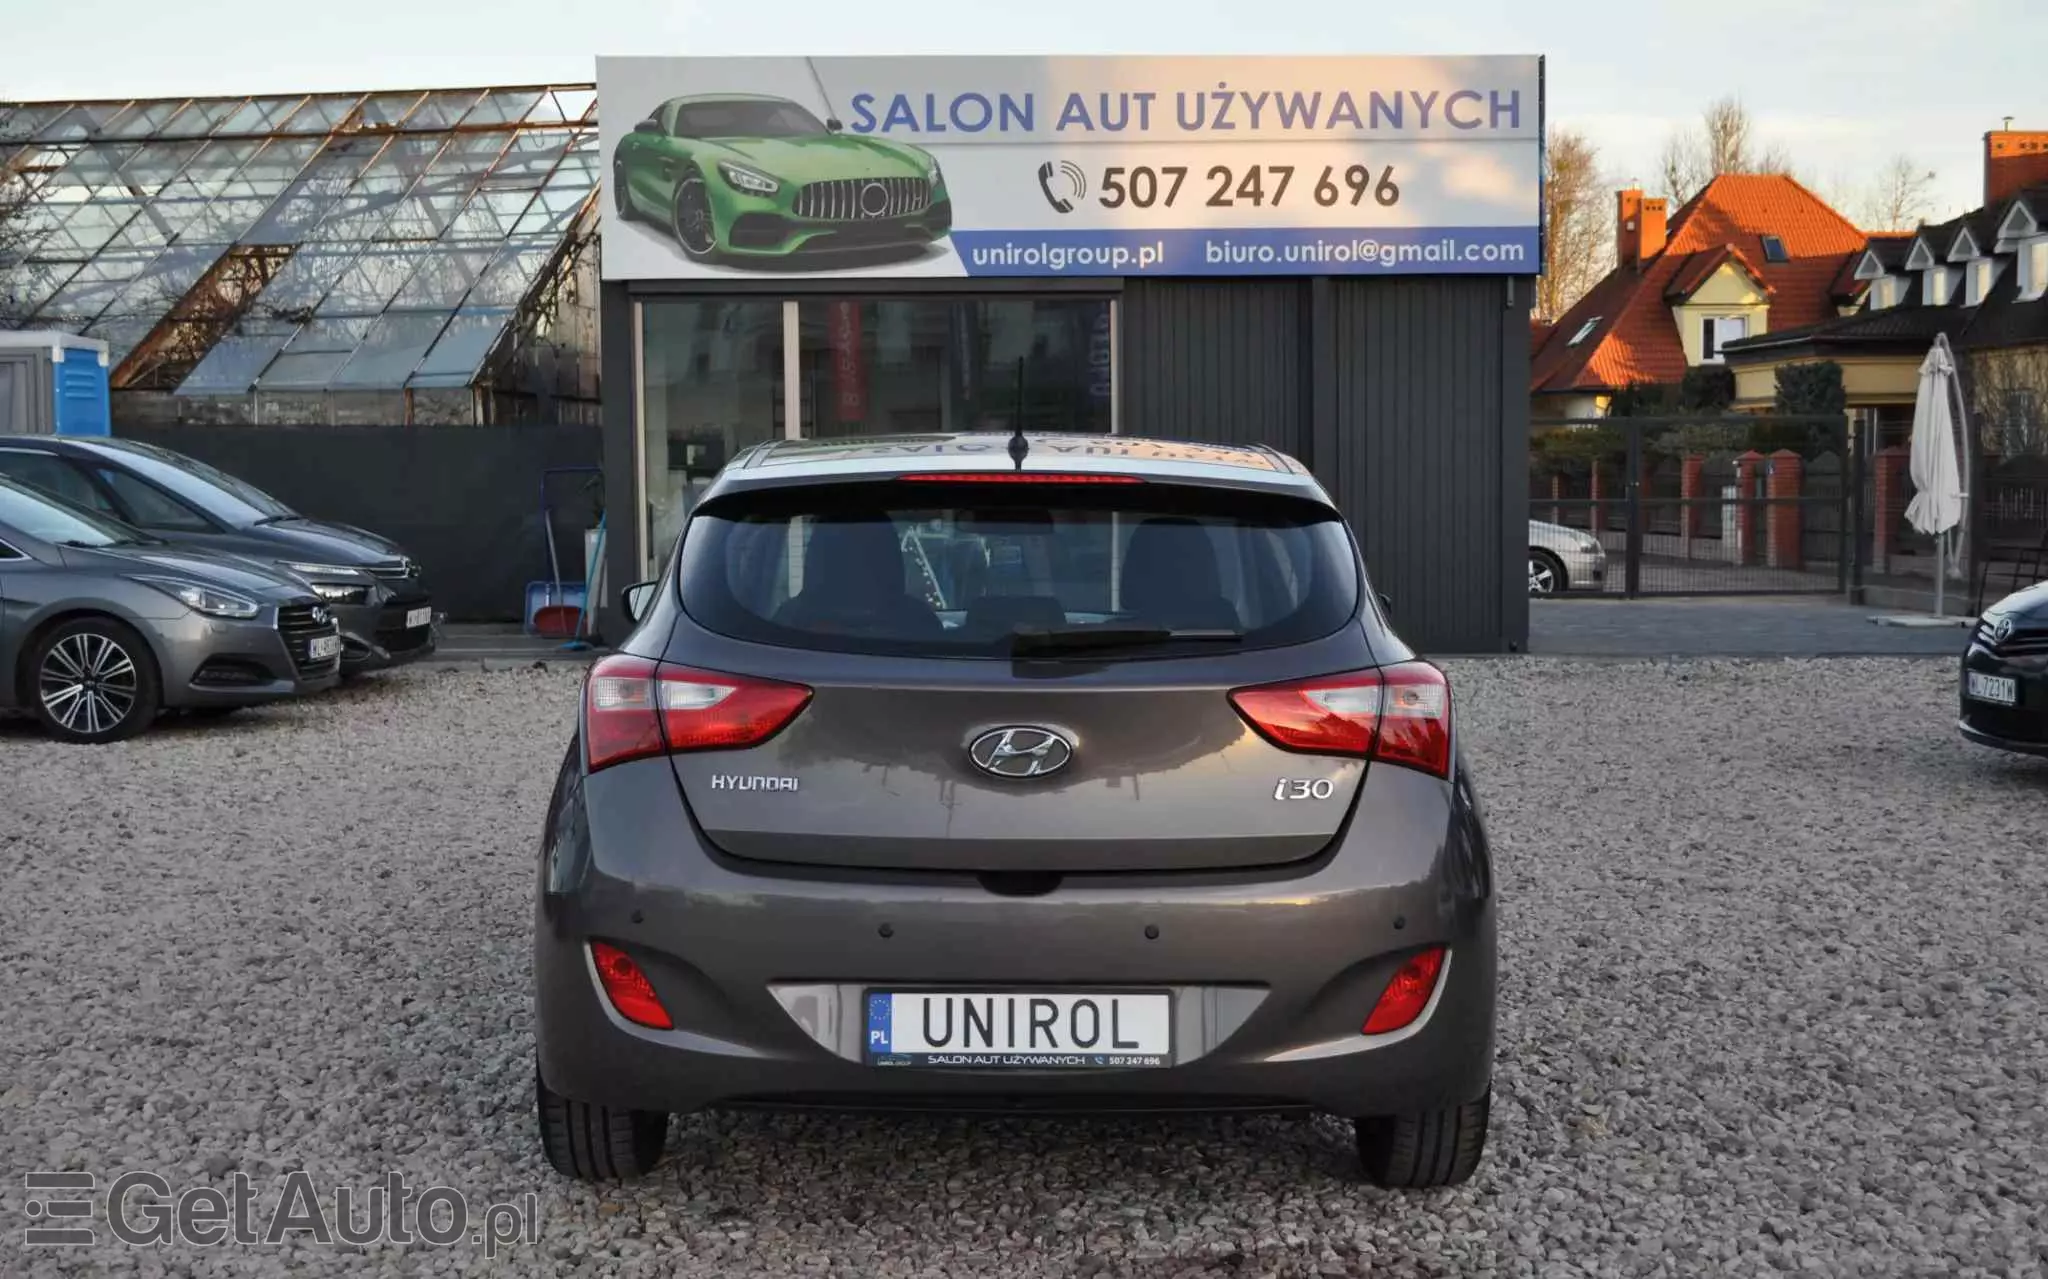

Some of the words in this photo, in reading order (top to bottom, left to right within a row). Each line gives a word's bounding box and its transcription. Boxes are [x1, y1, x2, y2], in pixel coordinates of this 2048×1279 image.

[851, 92, 1034, 133] SALON
[1056, 92, 1156, 132] AUT
[1176, 82, 1520, 132] UŻYWANYCH
[1098, 166, 1188, 208] 507
[1205, 164, 1295, 207] 247
[1314, 164, 1400, 207] 696
[972, 241, 1163, 270] unirolgroup.pl
[1205, 239, 1524, 267] biuro.unirol@gmail.com
[711, 774, 799, 791] HYUNDAI
[1274, 778, 1334, 801] i30
[923, 997, 1139, 1050] UNIROL
[870, 1030, 889, 1045] PL
[927, 1054, 972, 1065] SALON
[974, 1054, 1001, 1065] AUT
[1003, 1053, 1086, 1065] UŻYWANYCH
[1109, 1056, 1125, 1065] 507
